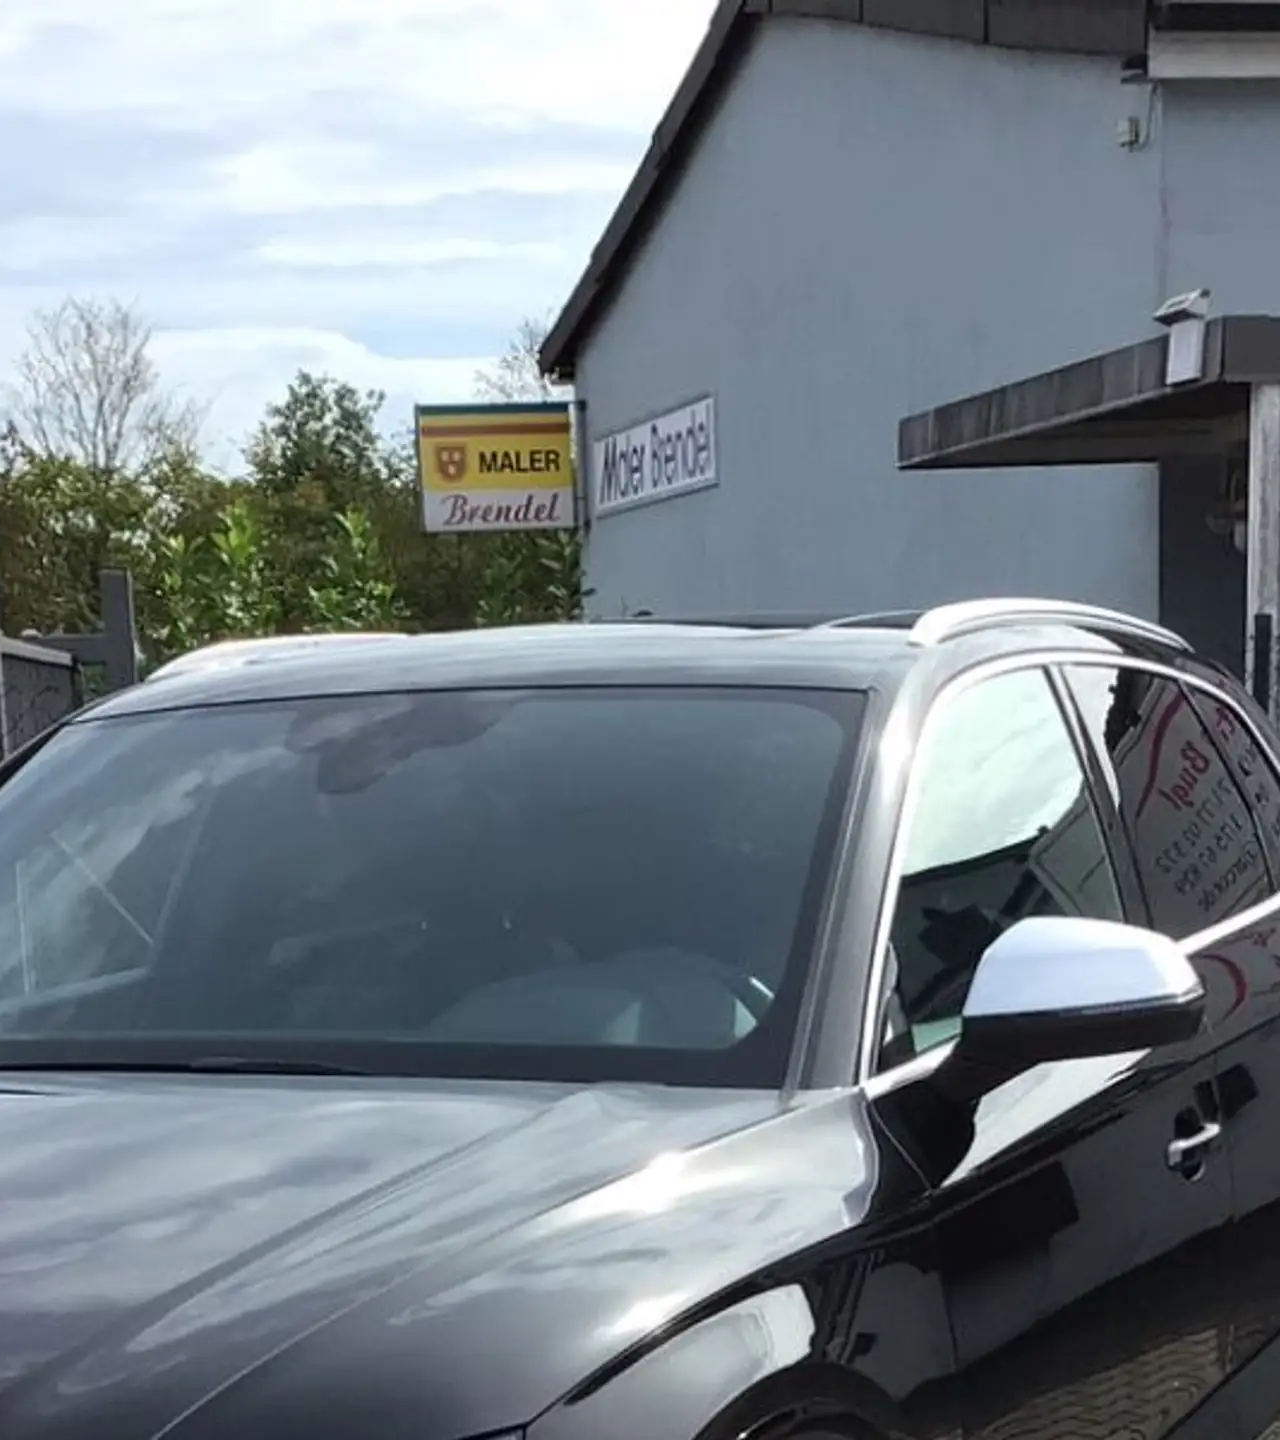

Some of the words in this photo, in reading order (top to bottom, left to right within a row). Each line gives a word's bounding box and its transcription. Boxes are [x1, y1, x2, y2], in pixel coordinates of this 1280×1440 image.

[478, 448, 562, 474] MALER
[650, 403, 713, 488] Brendel
[439, 492, 560, 526] Brendel
